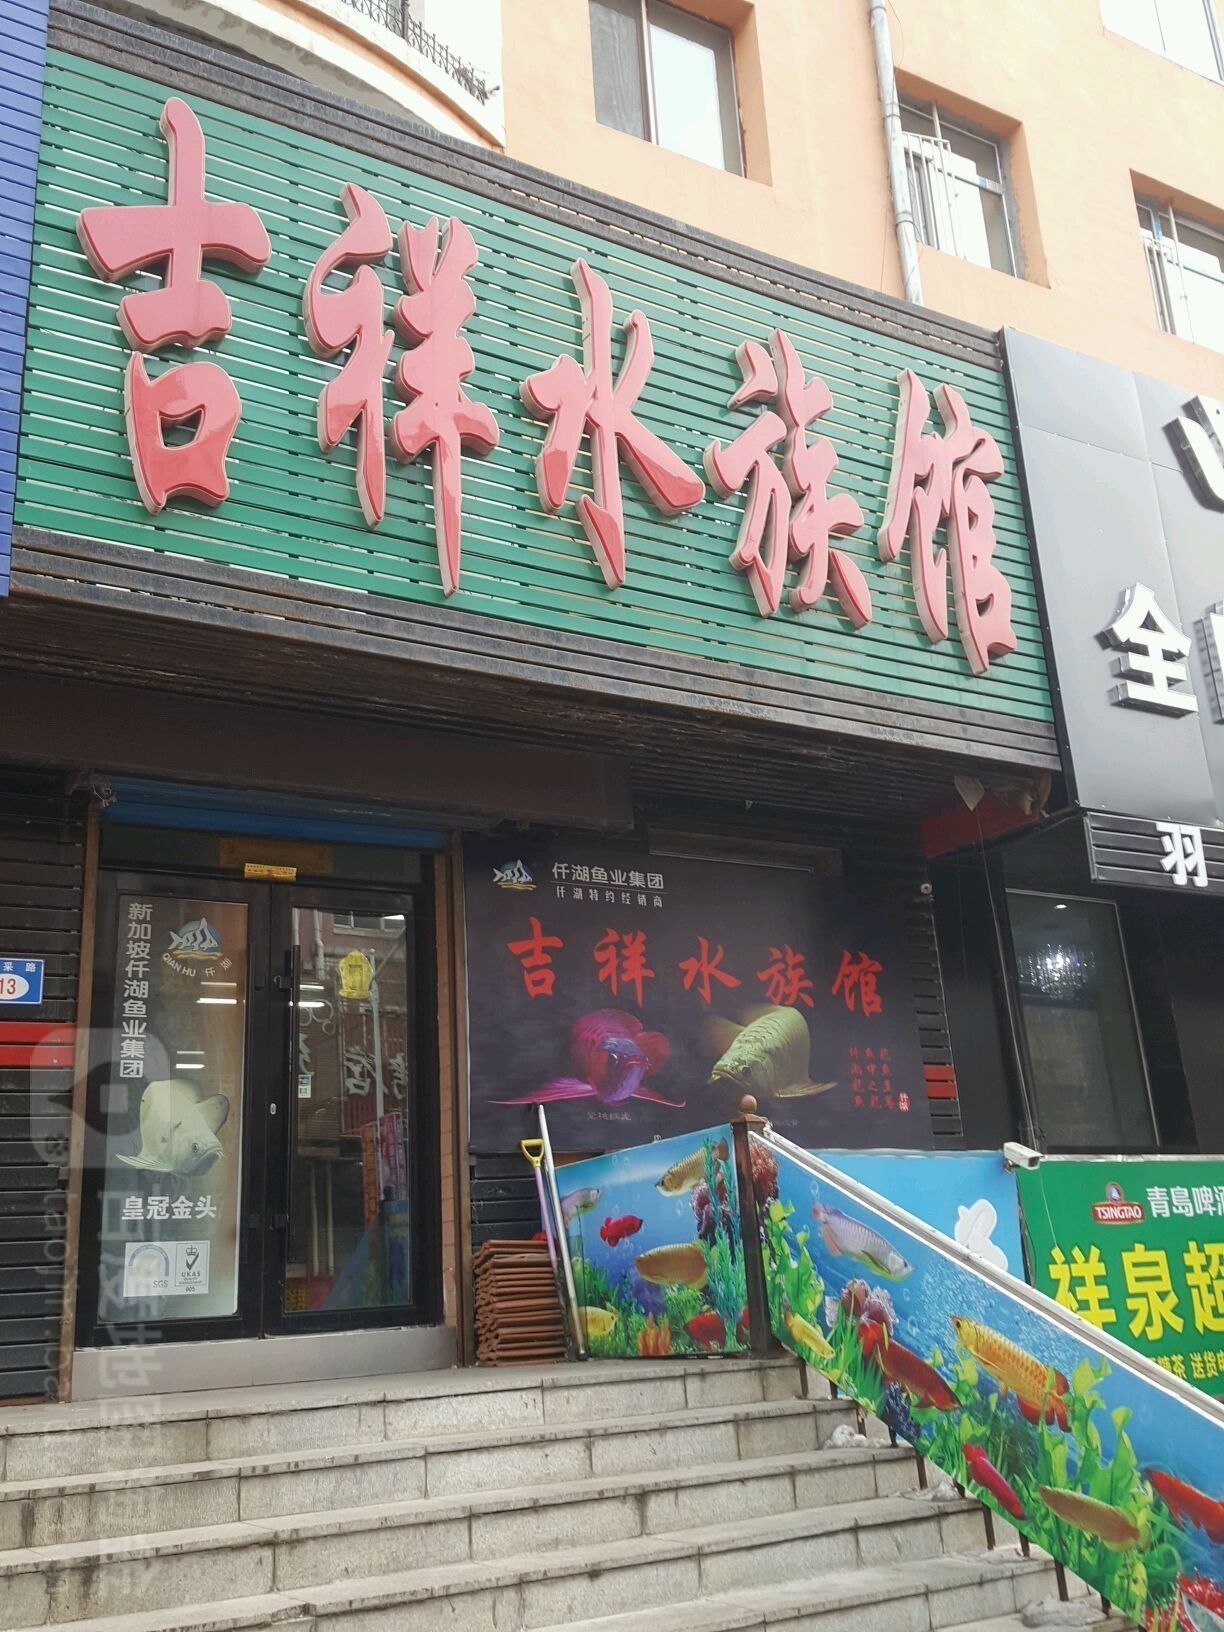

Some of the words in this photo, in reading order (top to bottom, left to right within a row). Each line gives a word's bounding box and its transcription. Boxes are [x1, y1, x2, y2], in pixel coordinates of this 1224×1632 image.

[75, 96, 1018, 677] 吉祥水族馆
[551, 861, 664, 889] 仟湖鱼业集团
[181, 966, 197, 977] HU
[508, 916, 884, 1018] 吉祥水族馆
[119, 902, 153, 1078] 新加坡仟湖鱼业集团
[121, 1195, 217, 1220] 皇冠金头
[1094, 1205, 1142, 1219] TSINGTAO
[152, 1279, 169, 1289] SGS
